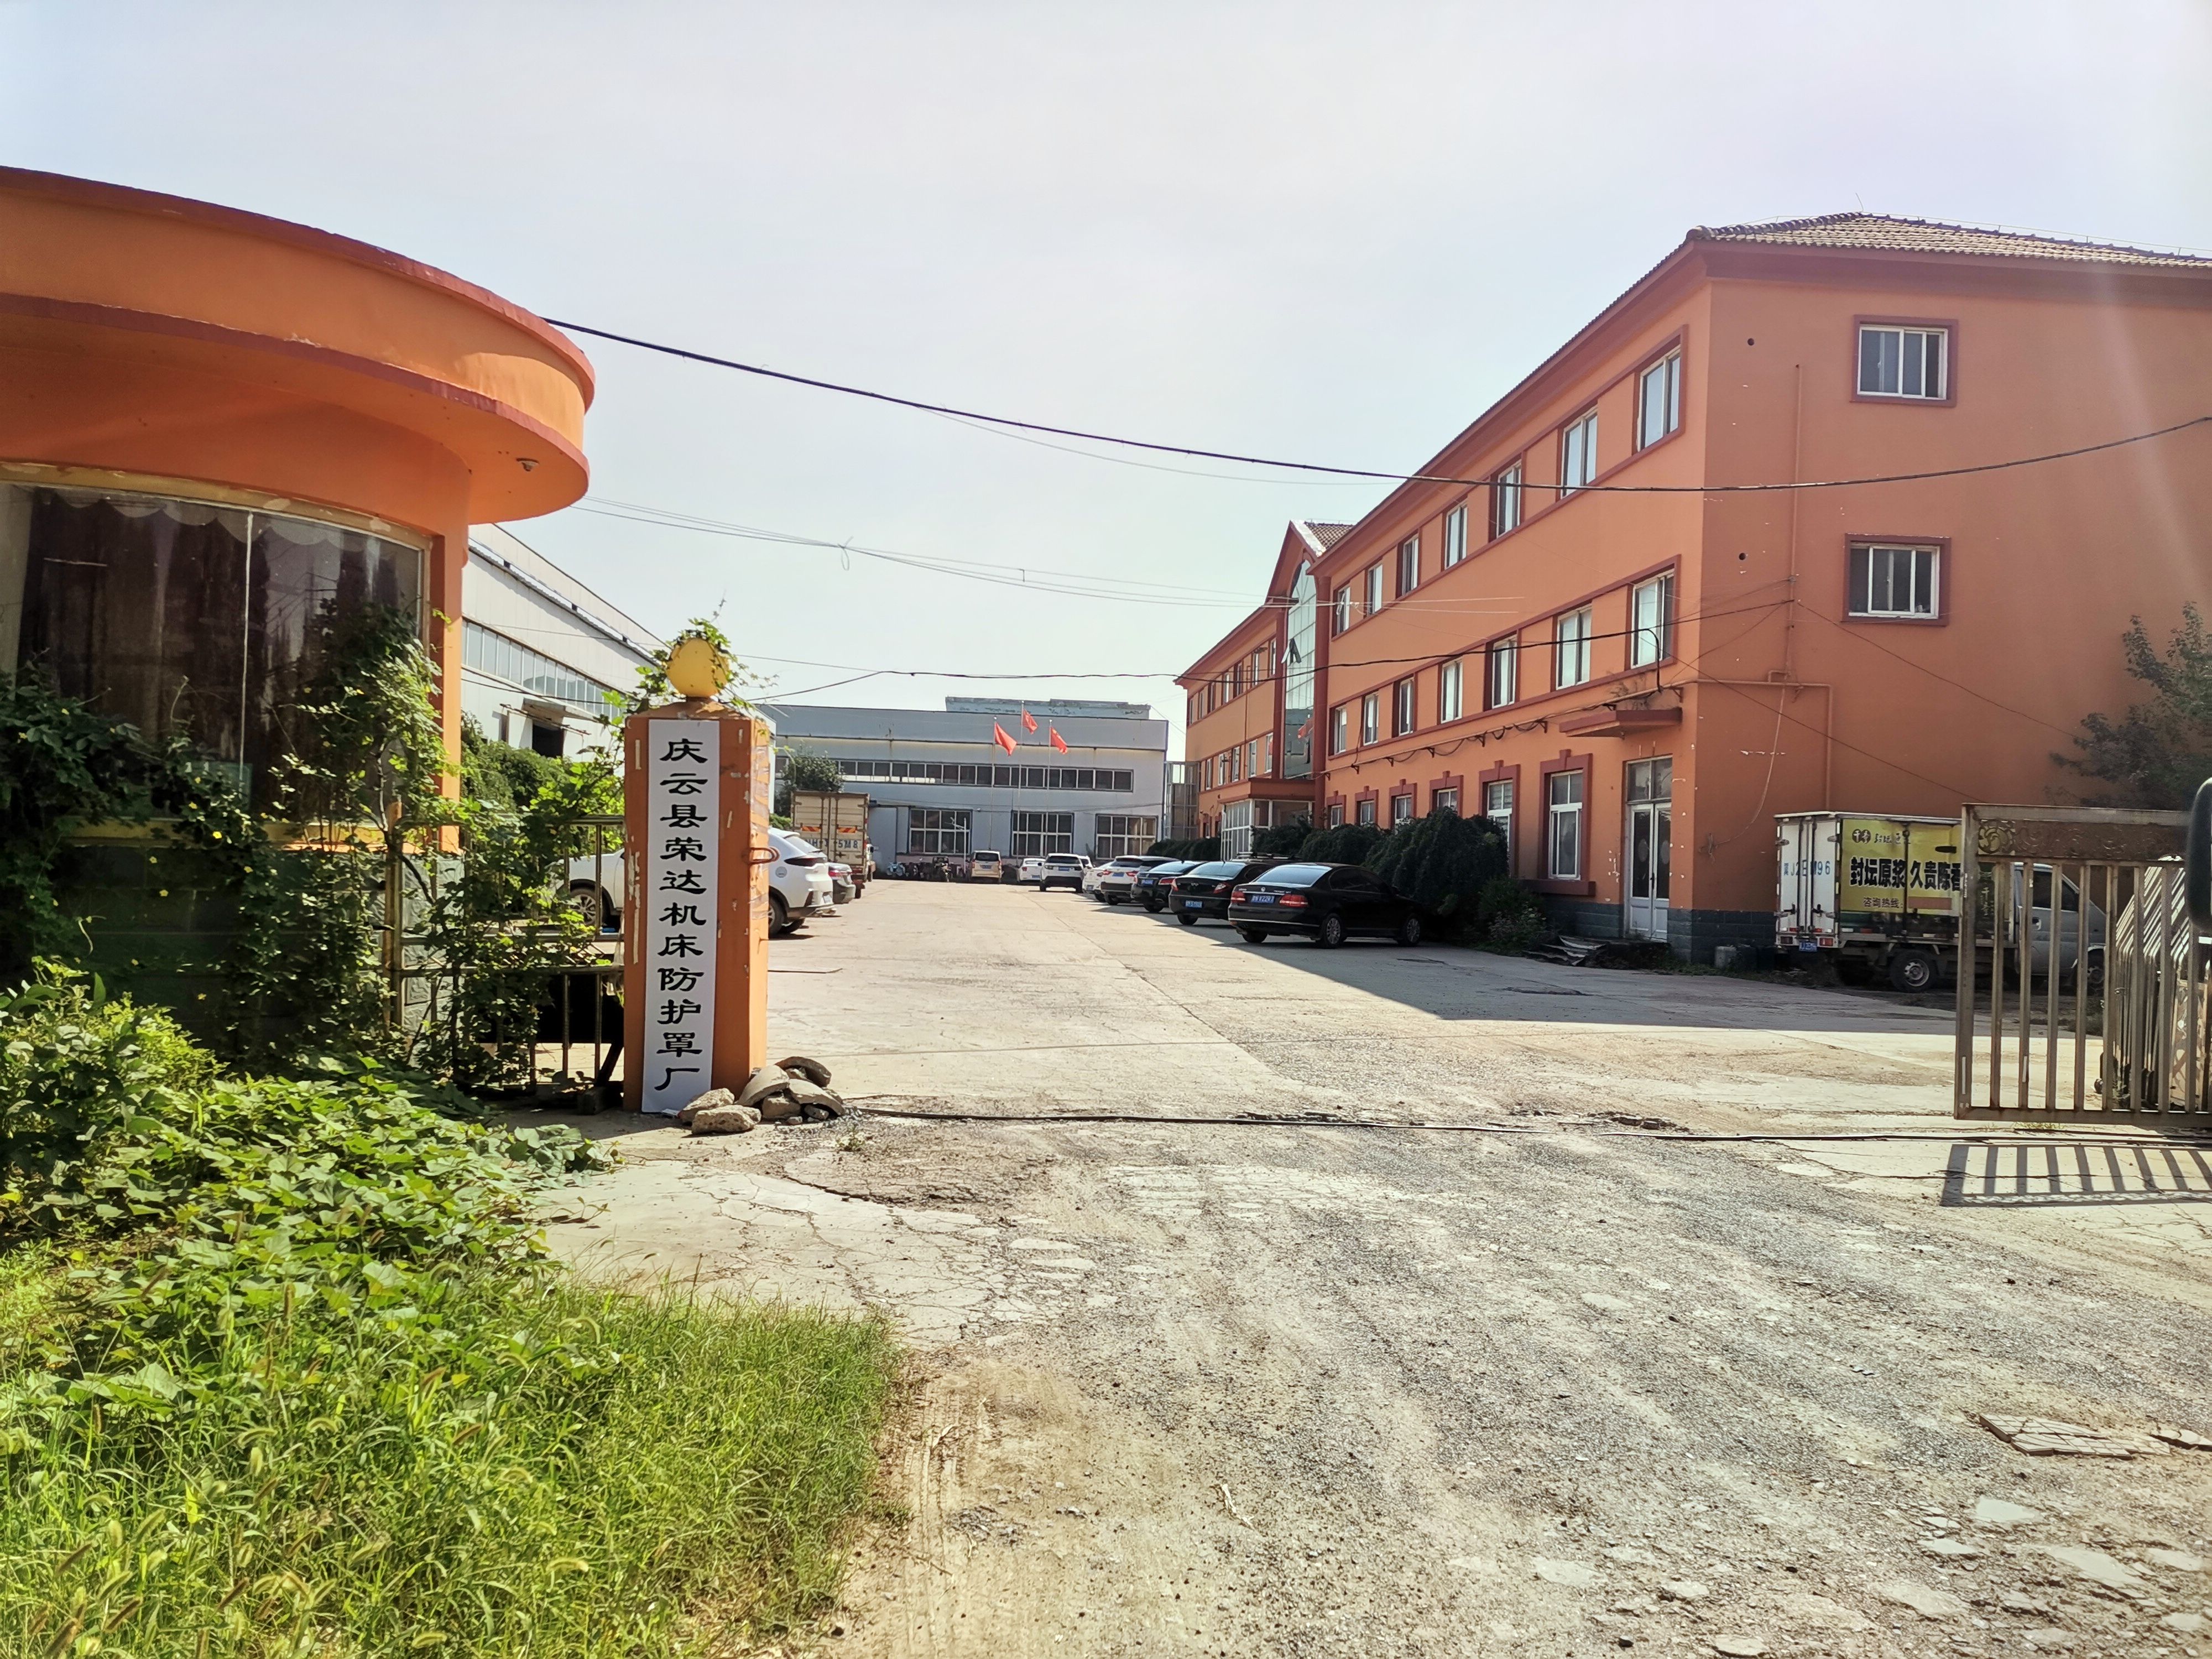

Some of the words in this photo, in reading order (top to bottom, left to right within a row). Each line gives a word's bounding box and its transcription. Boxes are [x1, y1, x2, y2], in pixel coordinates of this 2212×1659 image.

[655, 738, 708, 1091] 庆云县荣达机床防护罩厂
